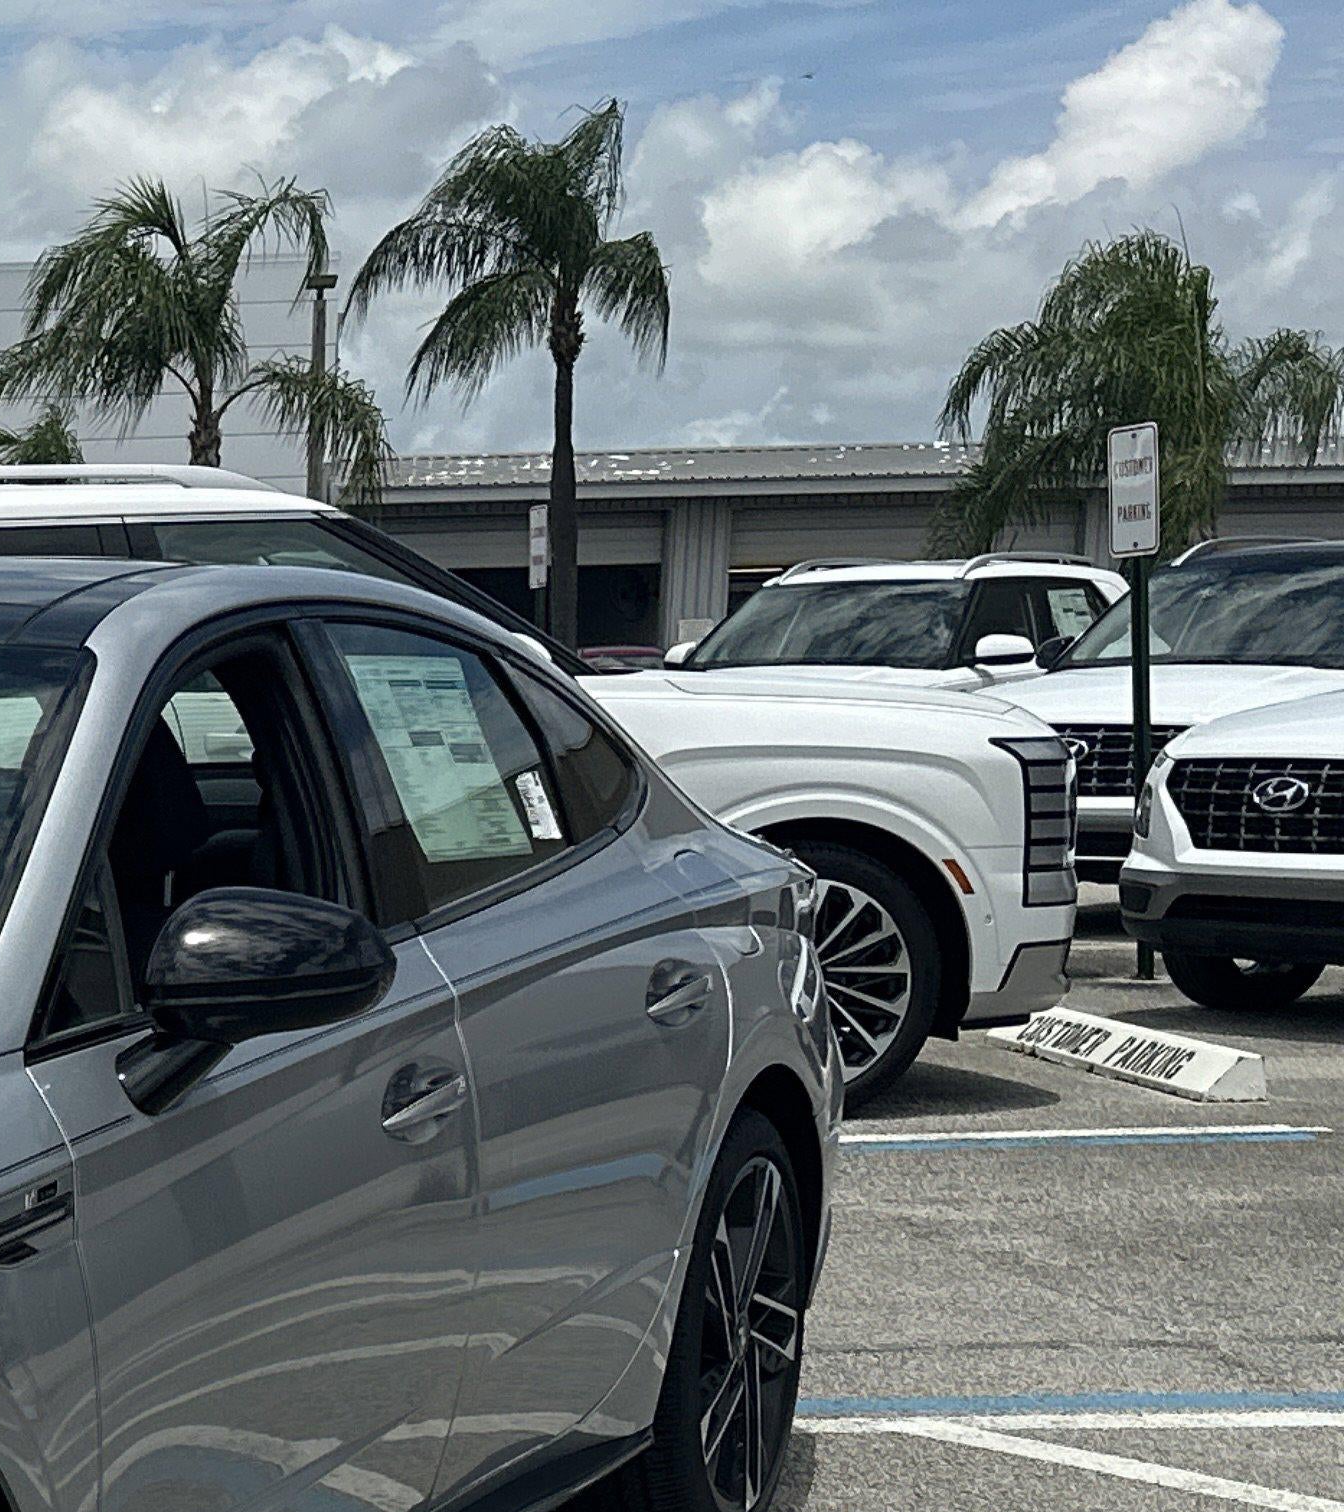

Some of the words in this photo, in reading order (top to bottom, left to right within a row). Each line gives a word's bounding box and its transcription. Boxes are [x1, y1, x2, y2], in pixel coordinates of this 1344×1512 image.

[1117, 502, 1151, 523] PARKING
[1016, 1015, 1112, 1058] CUSTOMER
[1101, 1035, 1196, 1080] PARKING
